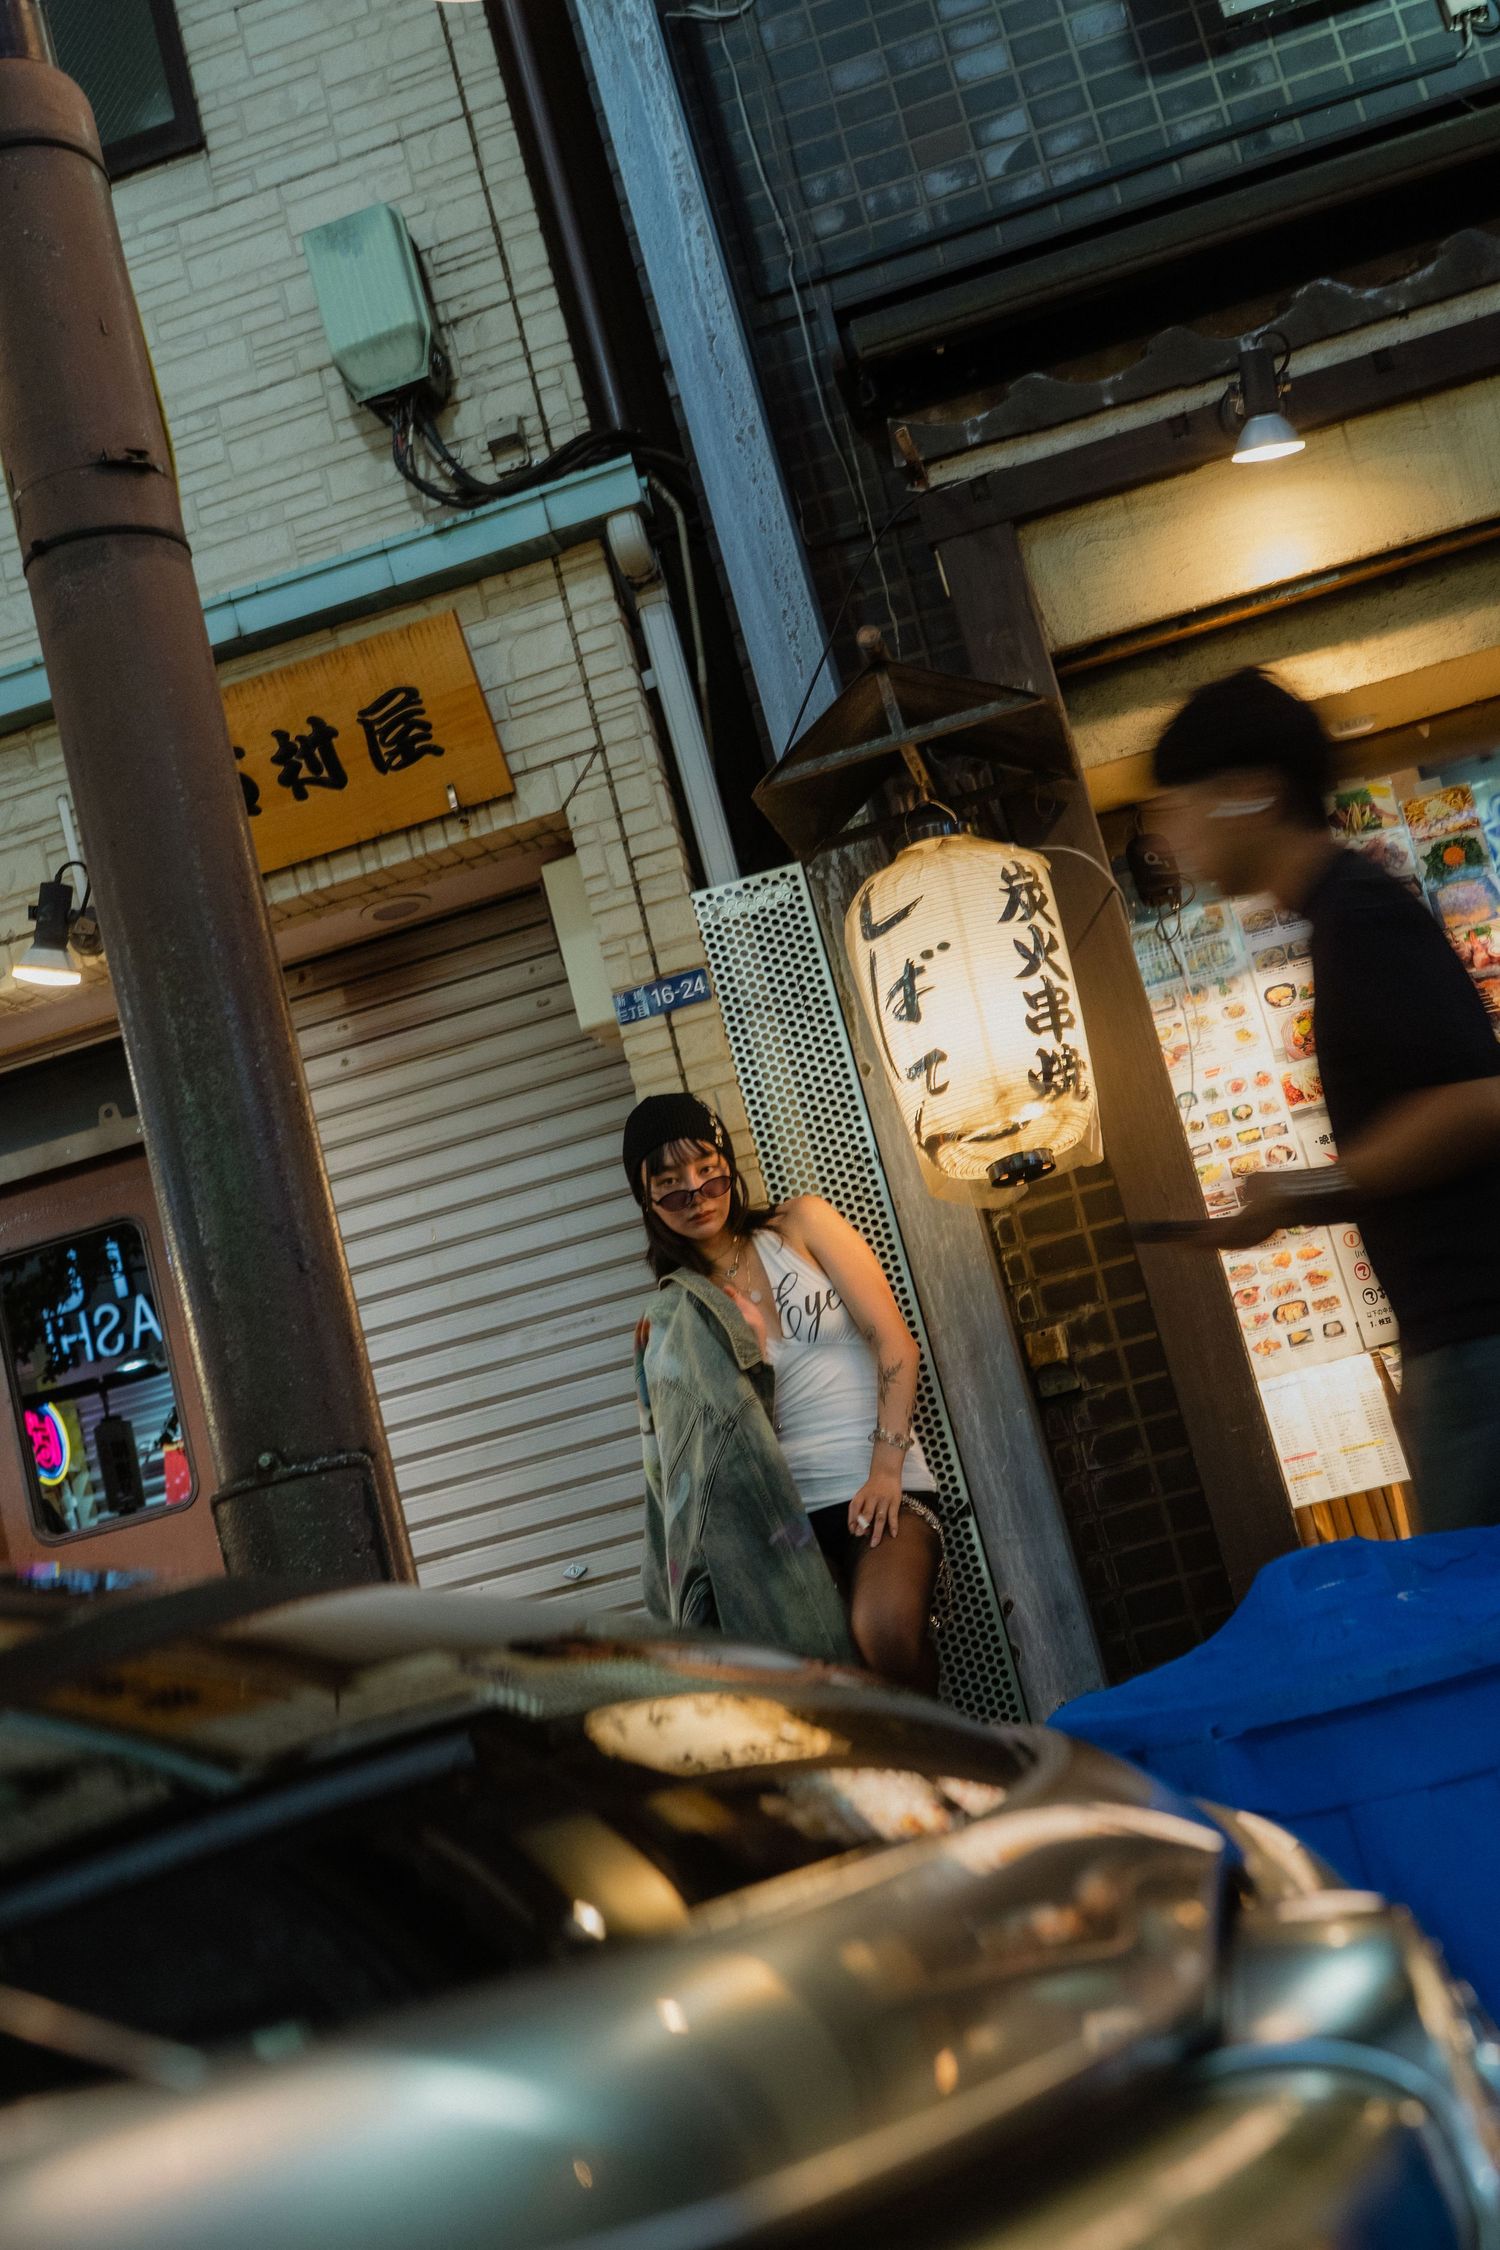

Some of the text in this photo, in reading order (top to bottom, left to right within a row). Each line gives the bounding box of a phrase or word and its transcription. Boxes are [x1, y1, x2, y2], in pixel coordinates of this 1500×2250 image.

[233, 686, 445, 816] 村屋
[651, 974, 706, 1007] 16-24
[997, 860, 1089, 1101] 炭火串焼
